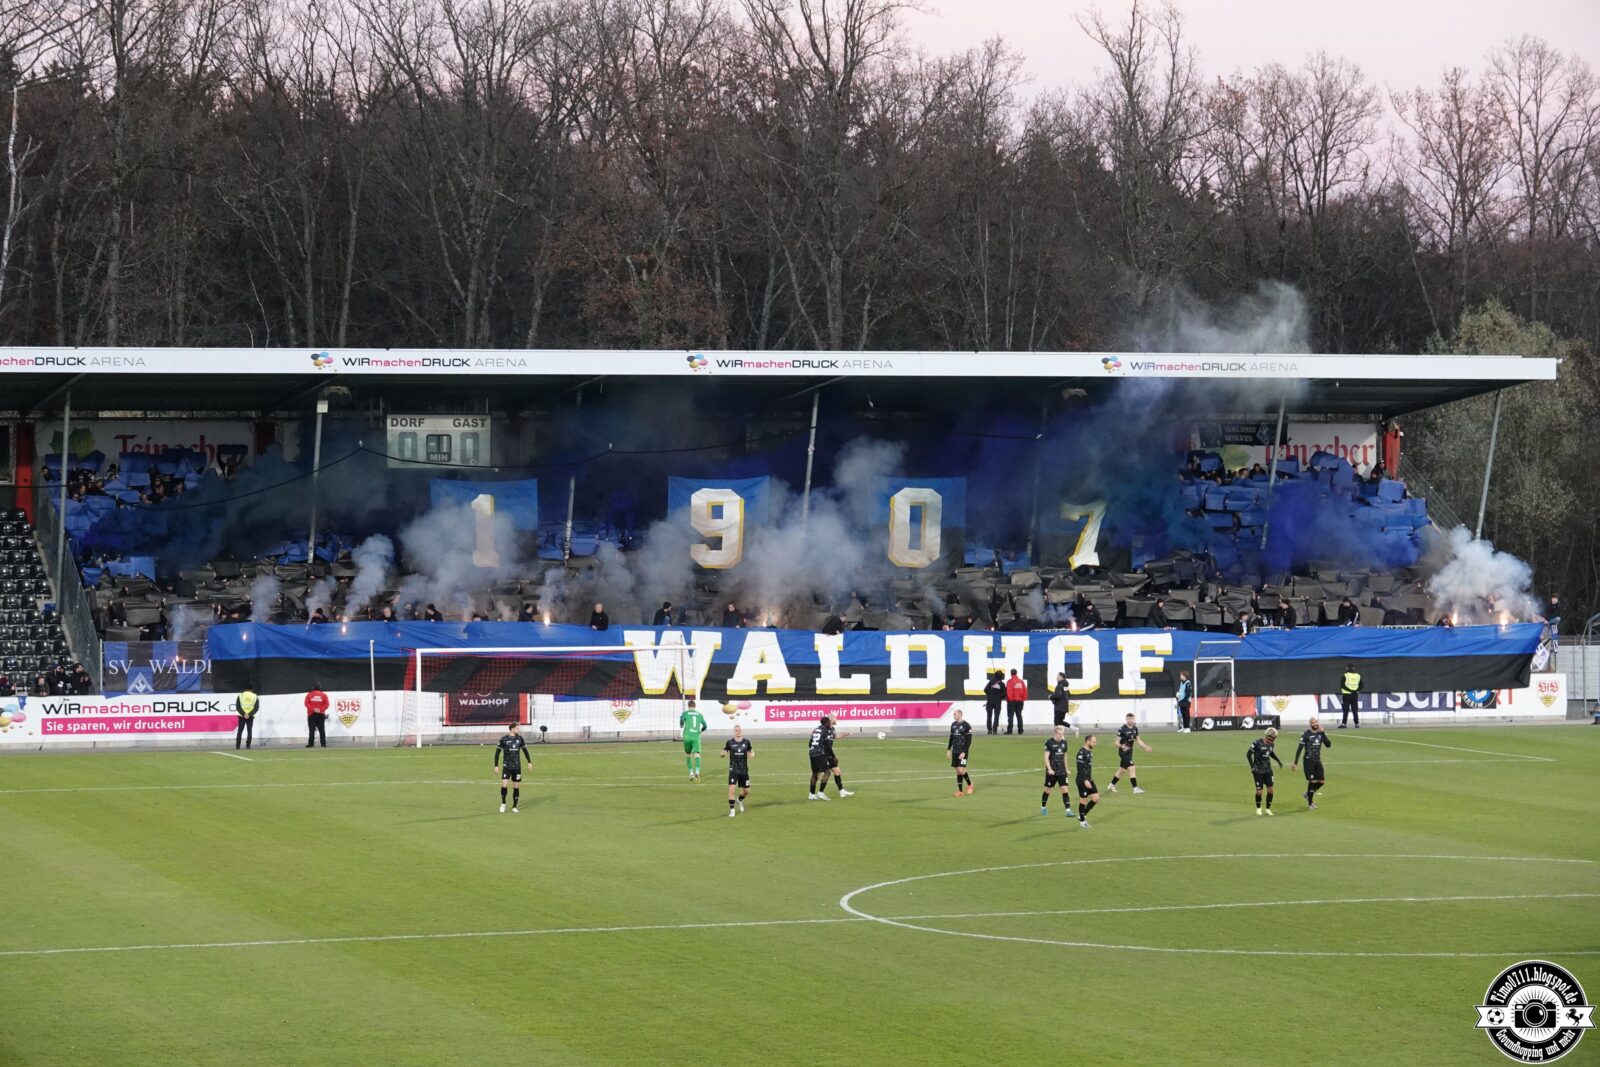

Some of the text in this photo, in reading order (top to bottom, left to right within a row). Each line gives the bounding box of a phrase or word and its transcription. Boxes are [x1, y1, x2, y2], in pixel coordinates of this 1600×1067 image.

[0, 356, 146, 367] chenDRUCK ARENA
[343, 358, 527, 367] WIRmachenDRUCK ARENA
[716, 359, 893, 369] WIRmachenDRUCK ARENA
[1130, 361, 1298, 371] WIRmachenDRUCK ARENA
[390, 418, 488, 428] DORF GAST
[470, 488, 1107, 569] 1 9 0 7
[109, 659, 133, 674] SV
[624, 629, 1172, 696] WALDHOF
[769, 706, 896, 720] Sie sparen, wir drucken!
[46, 720, 185, 732] Sie sparen, wir drucken!
[692, 716, 697, 728] 1
